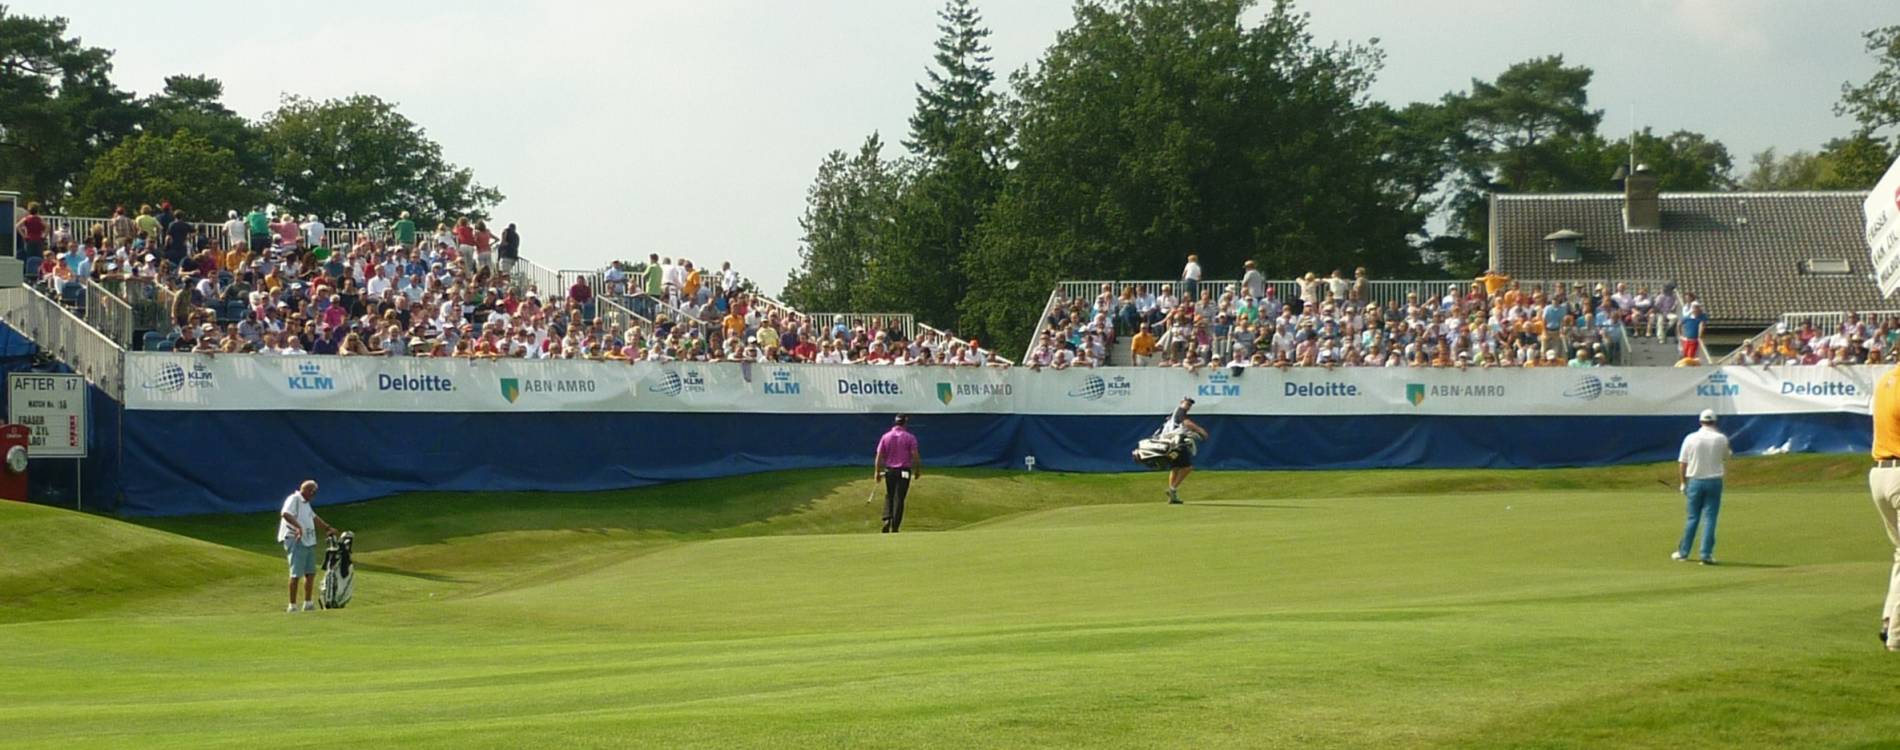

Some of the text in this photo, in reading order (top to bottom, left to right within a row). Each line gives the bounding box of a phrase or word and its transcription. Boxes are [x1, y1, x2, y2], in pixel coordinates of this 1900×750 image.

[188, 372, 213, 380] KLM
[15, 378, 78, 391] AFTER 17
[188, 380, 214, 388] OPEN
[288, 377, 334, 390] KLM
[763, 382, 800, 394] KLM
[1198, 385, 1240, 396] KLM
[1696, 384, 1739, 396] KLM
